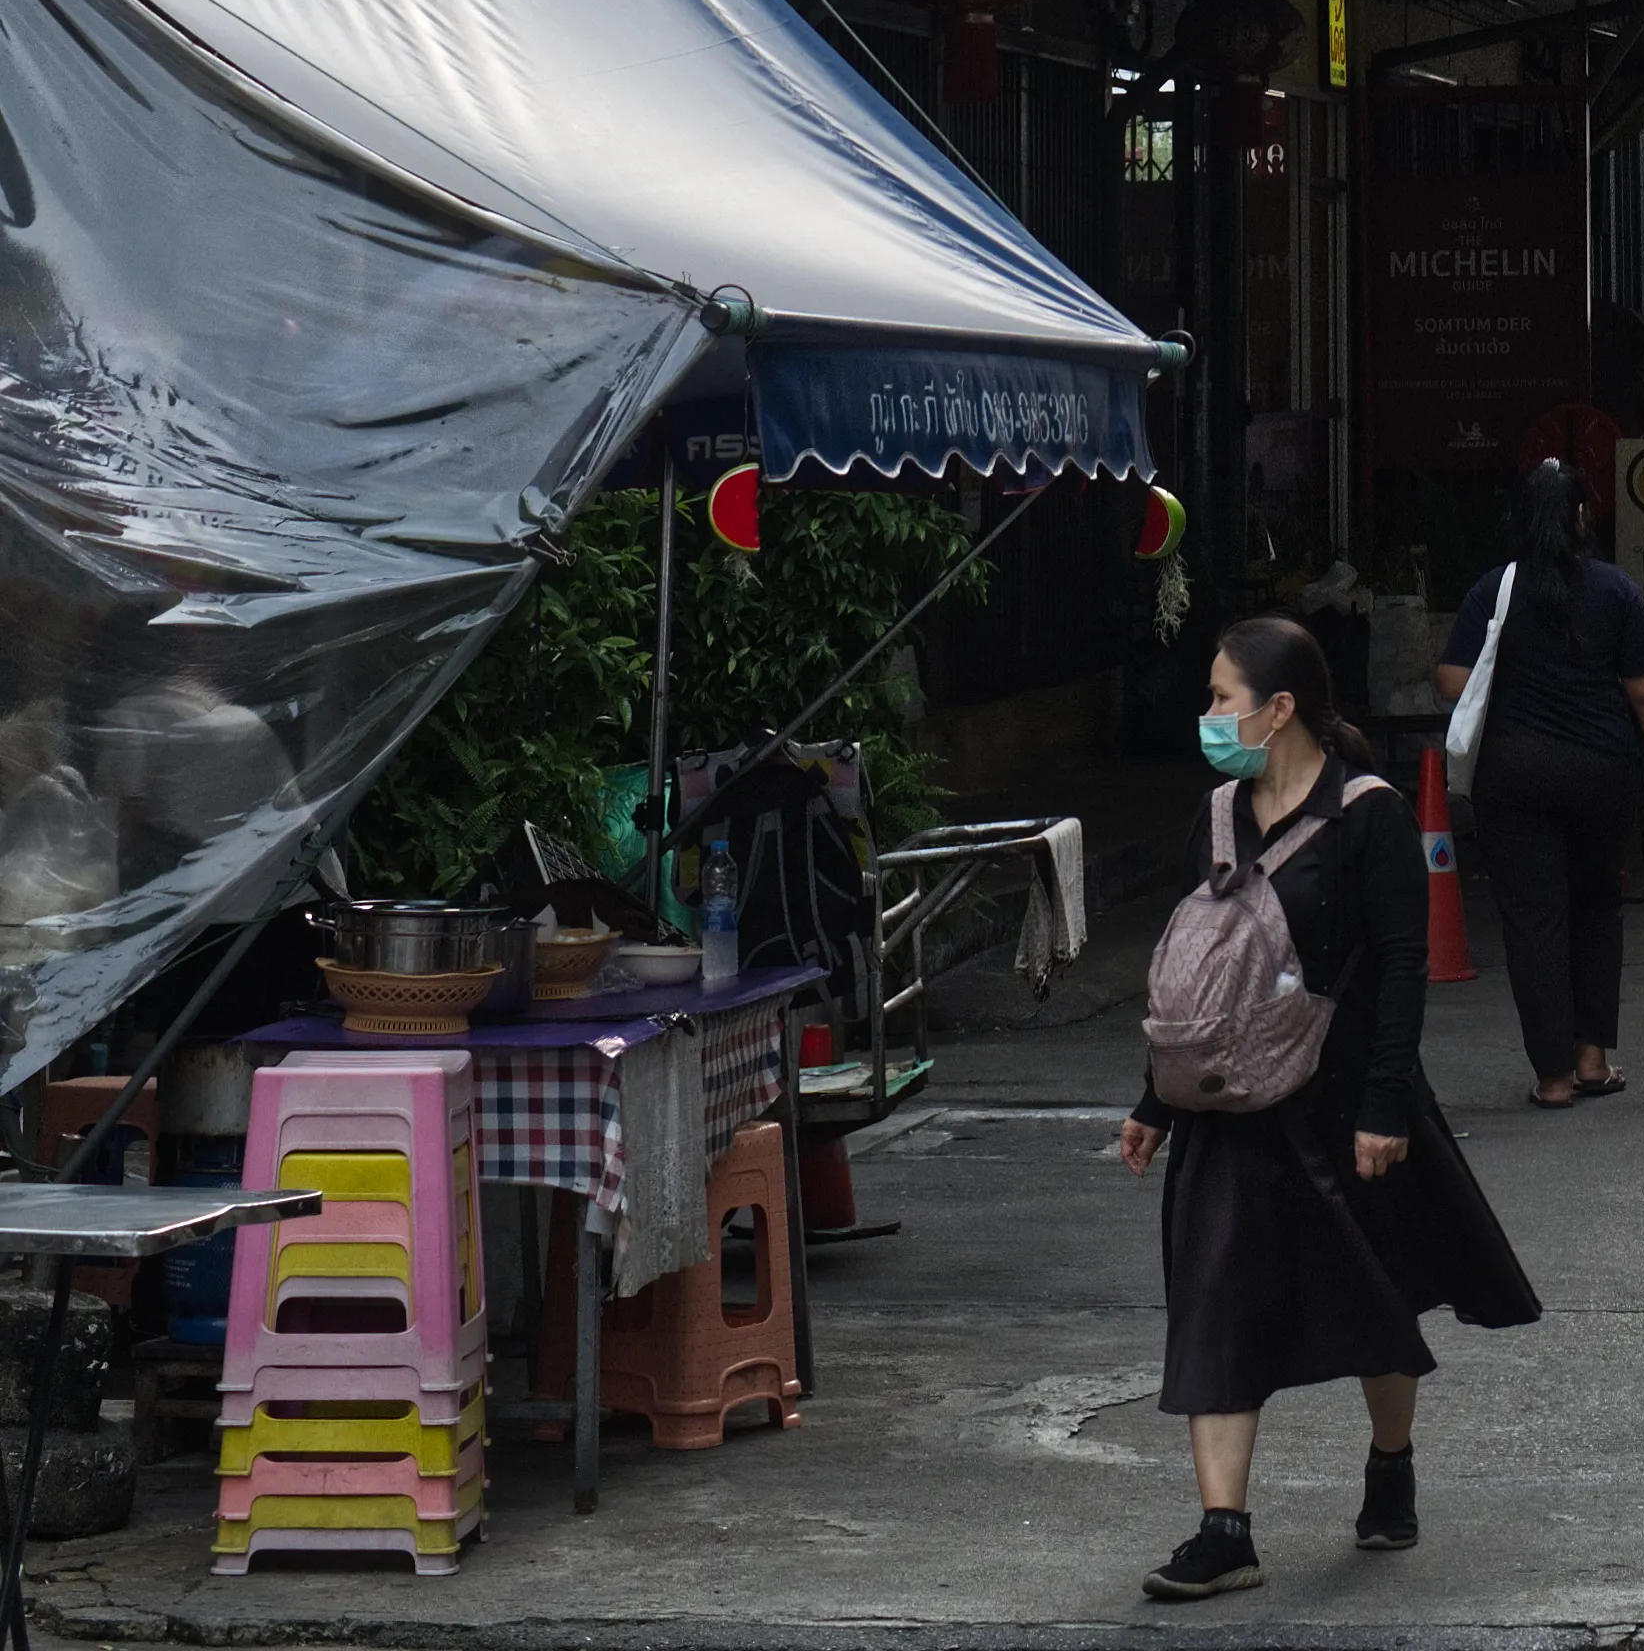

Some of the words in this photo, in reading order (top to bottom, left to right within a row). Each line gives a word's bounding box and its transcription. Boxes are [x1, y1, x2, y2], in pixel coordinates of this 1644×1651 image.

[1389, 248, 1556, 278] MICHELIN
[1452, 280, 1492, 292] GUIDE
[1414, 316, 1491, 333] SOMTUM
[1497, 316, 1531, 332] DER
